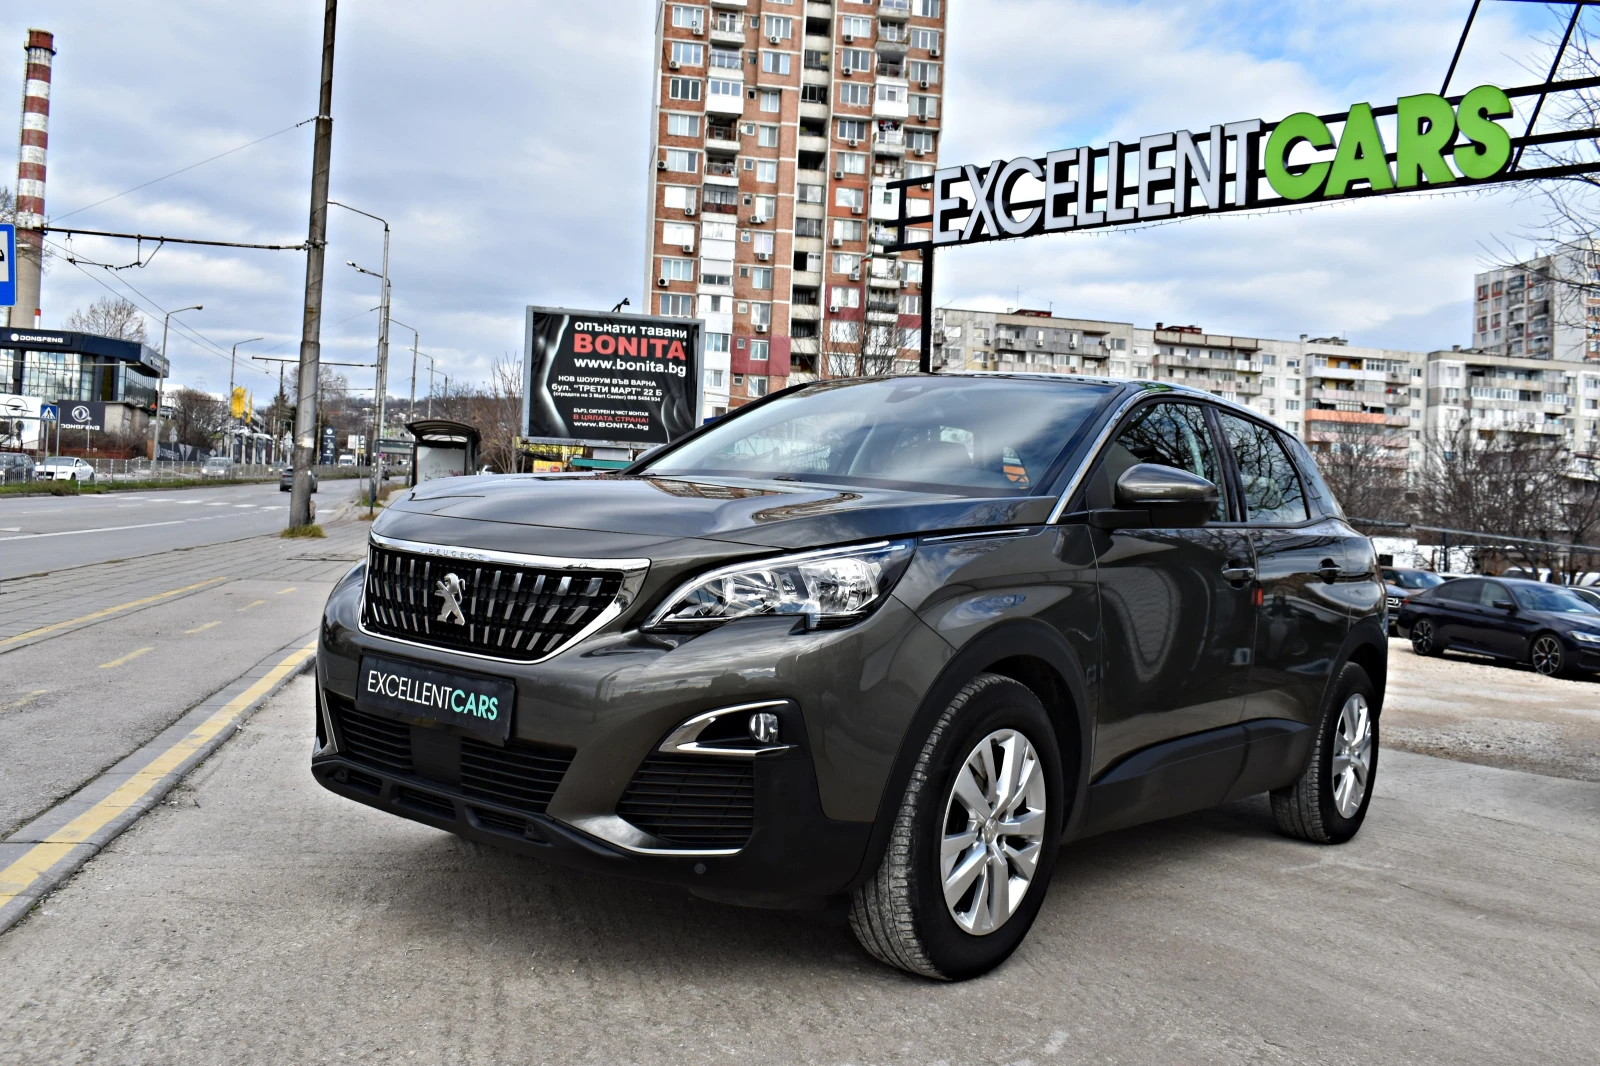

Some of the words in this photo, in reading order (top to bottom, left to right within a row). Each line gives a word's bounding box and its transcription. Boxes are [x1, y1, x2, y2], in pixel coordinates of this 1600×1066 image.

[574, 321, 636, 335] опънати
[639, 326, 687, 339] тавани
[20, 335, 64, 343] DONGFENG
[573, 333, 686, 360] BONITA
[574, 358, 687, 377] www.bonita.bg
[576, 376, 611, 384] ШОУРУМ
[630, 379, 657, 387] ВАРНА
[551, 383, 571, 391] бул.
[573, 384, 608, 393] "ТРЕТИ
[643, 388, 654, 396] 22
[615, 415, 649, 423] СТРАНА!
[573, 421, 649, 431] www.BONITA.bg
[428, 548, 483, 560] PEUGEOT
